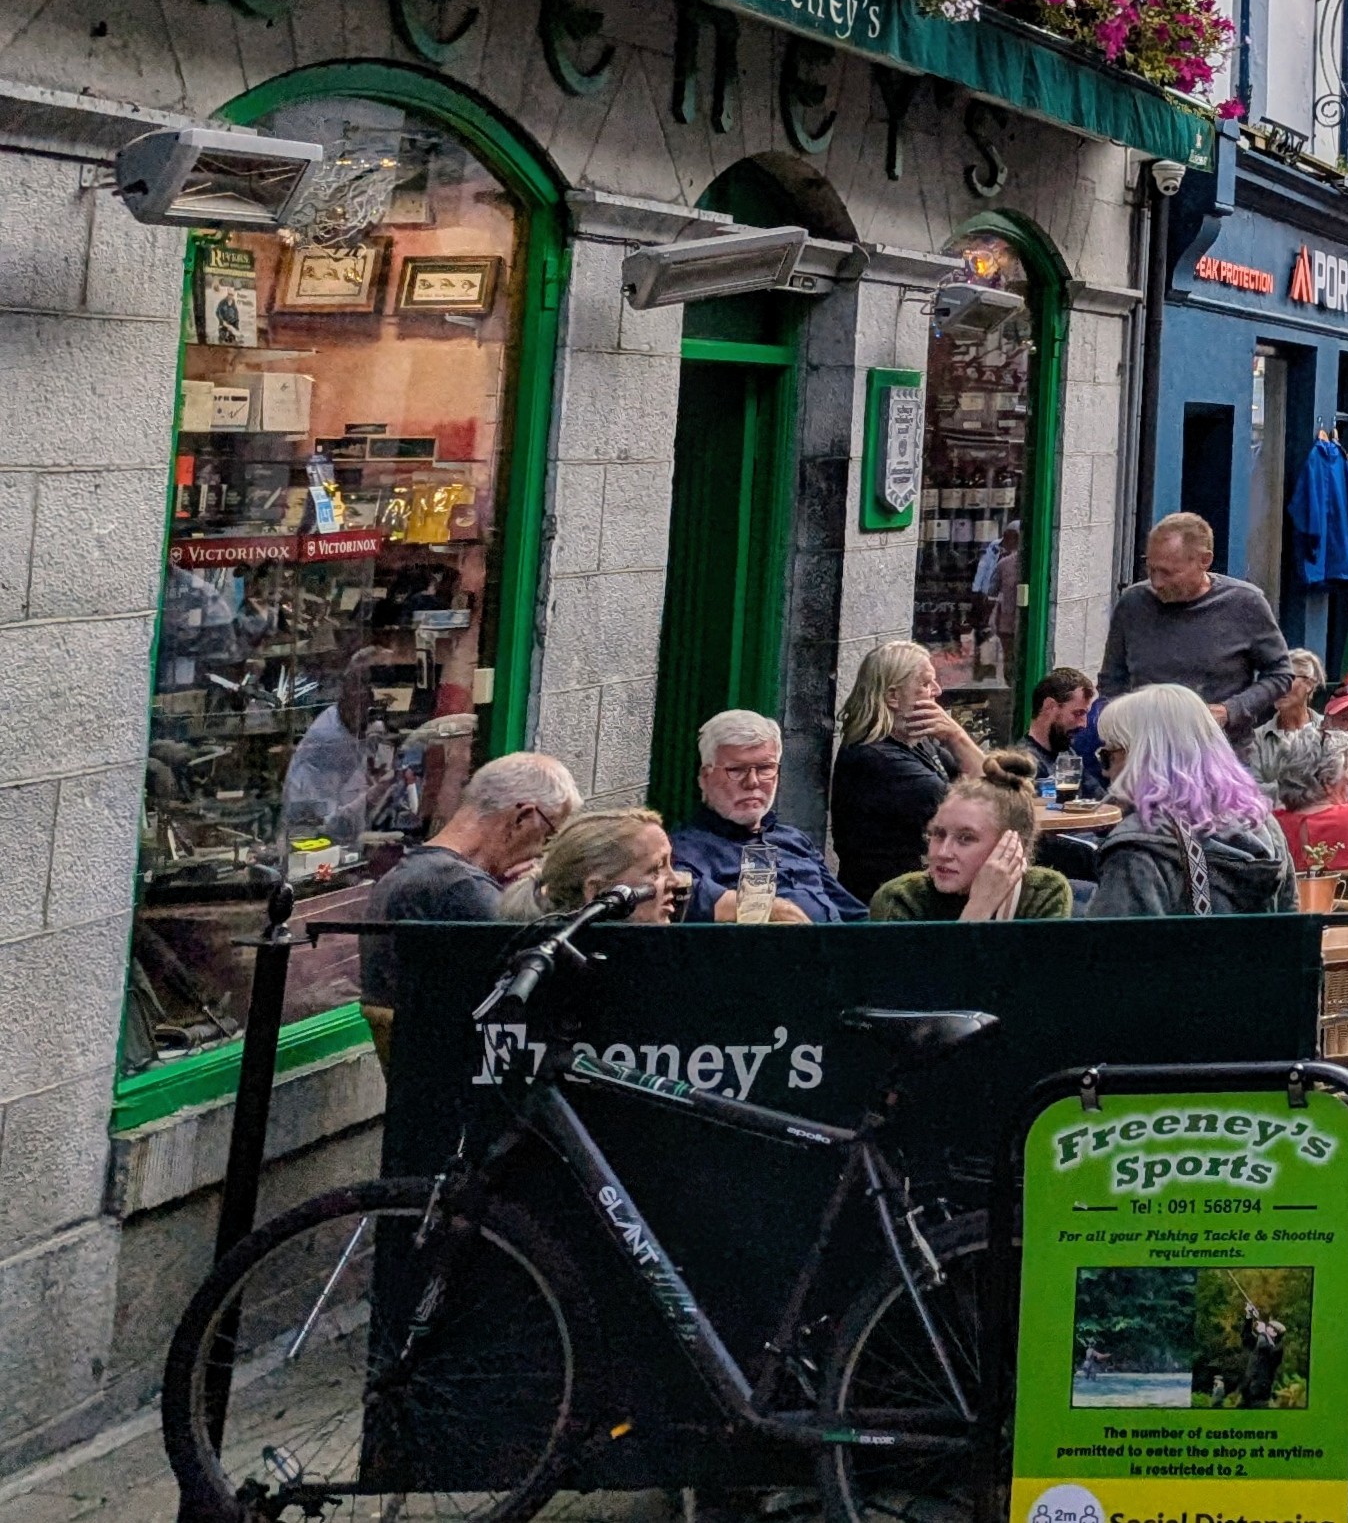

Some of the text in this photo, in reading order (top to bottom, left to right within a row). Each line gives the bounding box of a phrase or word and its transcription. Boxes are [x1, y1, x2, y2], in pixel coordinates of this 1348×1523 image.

[1220, 261, 1274, 294] PROTECTION
[187, 546, 291, 562] VICTORINOX
[318, 538, 378, 556] VICTORINOX
[1057, 1112, 1333, 1166] Freeney's
[1116, 1155, 1273, 1189] Sports
[1131, 1200, 1151, 1215] Tel
[1167, 1199, 1197, 1215] 091
[1204, 1199, 1263, 1215] 568794
[599, 1185, 660, 1266] SLANT
[1058, 1229, 1336, 1246] For all your Fishing Tackle & Shooting
[1149, 1246, 1246, 1260] requirements.
[1104, 1427, 1279, 1440] The number of customers
[1057, 1445, 1324, 1461] permitted to enter the shop at anytime
[1130, 1463, 1249, 1476] is restricted to 2.
[1055, 1510, 1077, 1523] 2m
